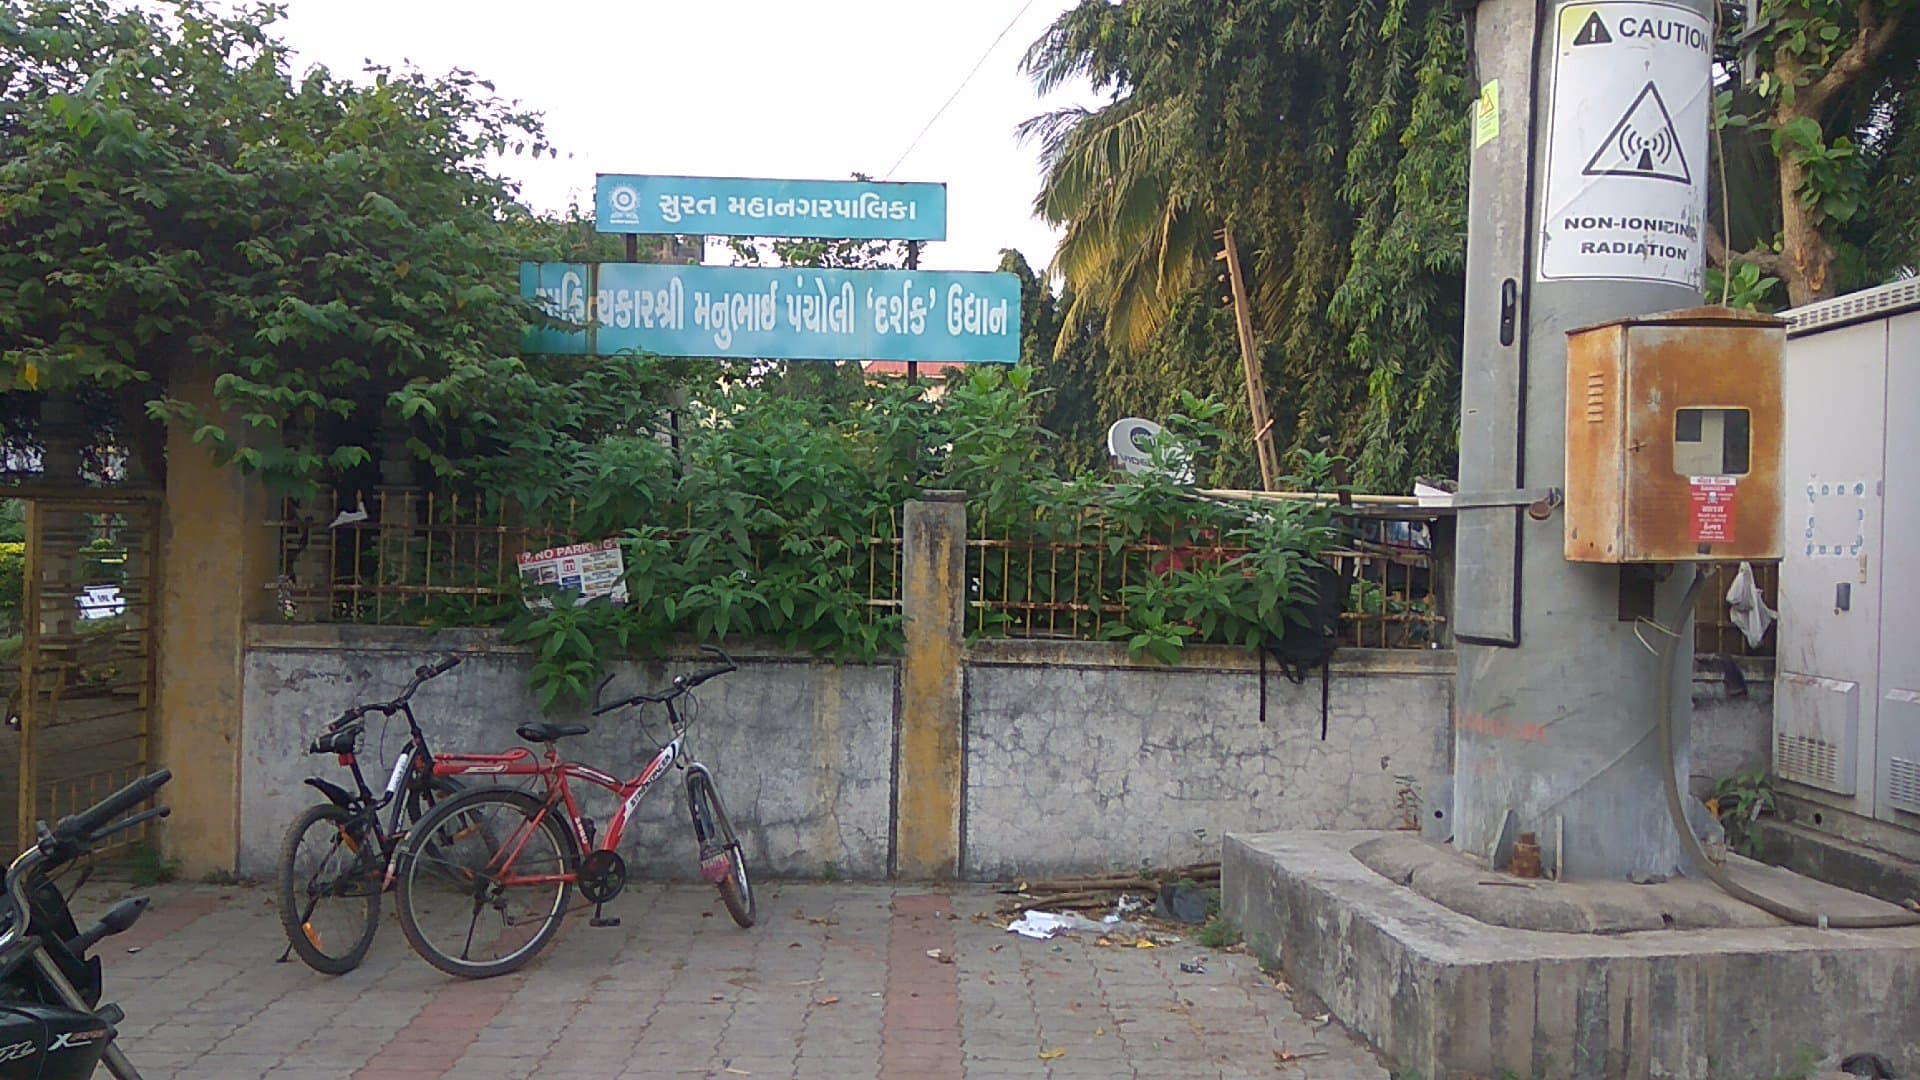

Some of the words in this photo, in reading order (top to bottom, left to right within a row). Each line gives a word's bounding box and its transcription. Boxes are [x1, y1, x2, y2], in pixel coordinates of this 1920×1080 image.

[1619, 17, 1709, 55] CAUTION
[659, 193, 716, 222] સુરત
[728, 192, 916, 220] મહાનગરપાલિકા
[1581, 242, 1687, 260] RADIATION
[694, 279, 776, 350] મનુભાઈ
[786, 274, 855, 334] પંચોલી
[556, 540, 612, 558] PARKG
